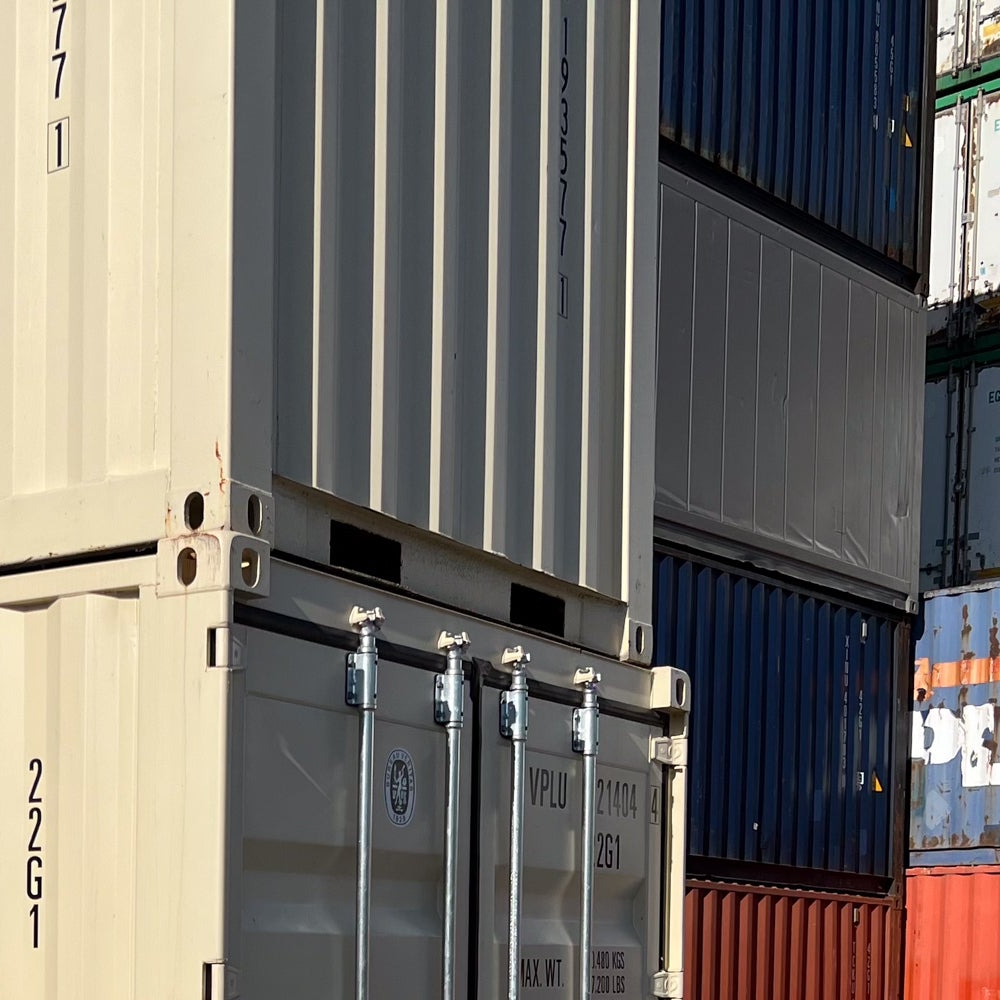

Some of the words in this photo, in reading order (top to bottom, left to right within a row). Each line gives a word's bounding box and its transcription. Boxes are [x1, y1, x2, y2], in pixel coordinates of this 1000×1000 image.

[52, 0, 67, 100] 77
[55, 122, 62, 168] 1
[529, 767, 568, 810] VPLU
[597, 779, 637, 819] 21404
[651, 788, 658, 823] 4
[26, 759, 43, 948] 22G1
[596, 832, 620, 870] 2G1
[545, 958, 565, 987] WT.
[612, 951, 625, 969] KGS
[592, 975, 609, 994] 7.200
[613, 975, 625, 993] LBS
